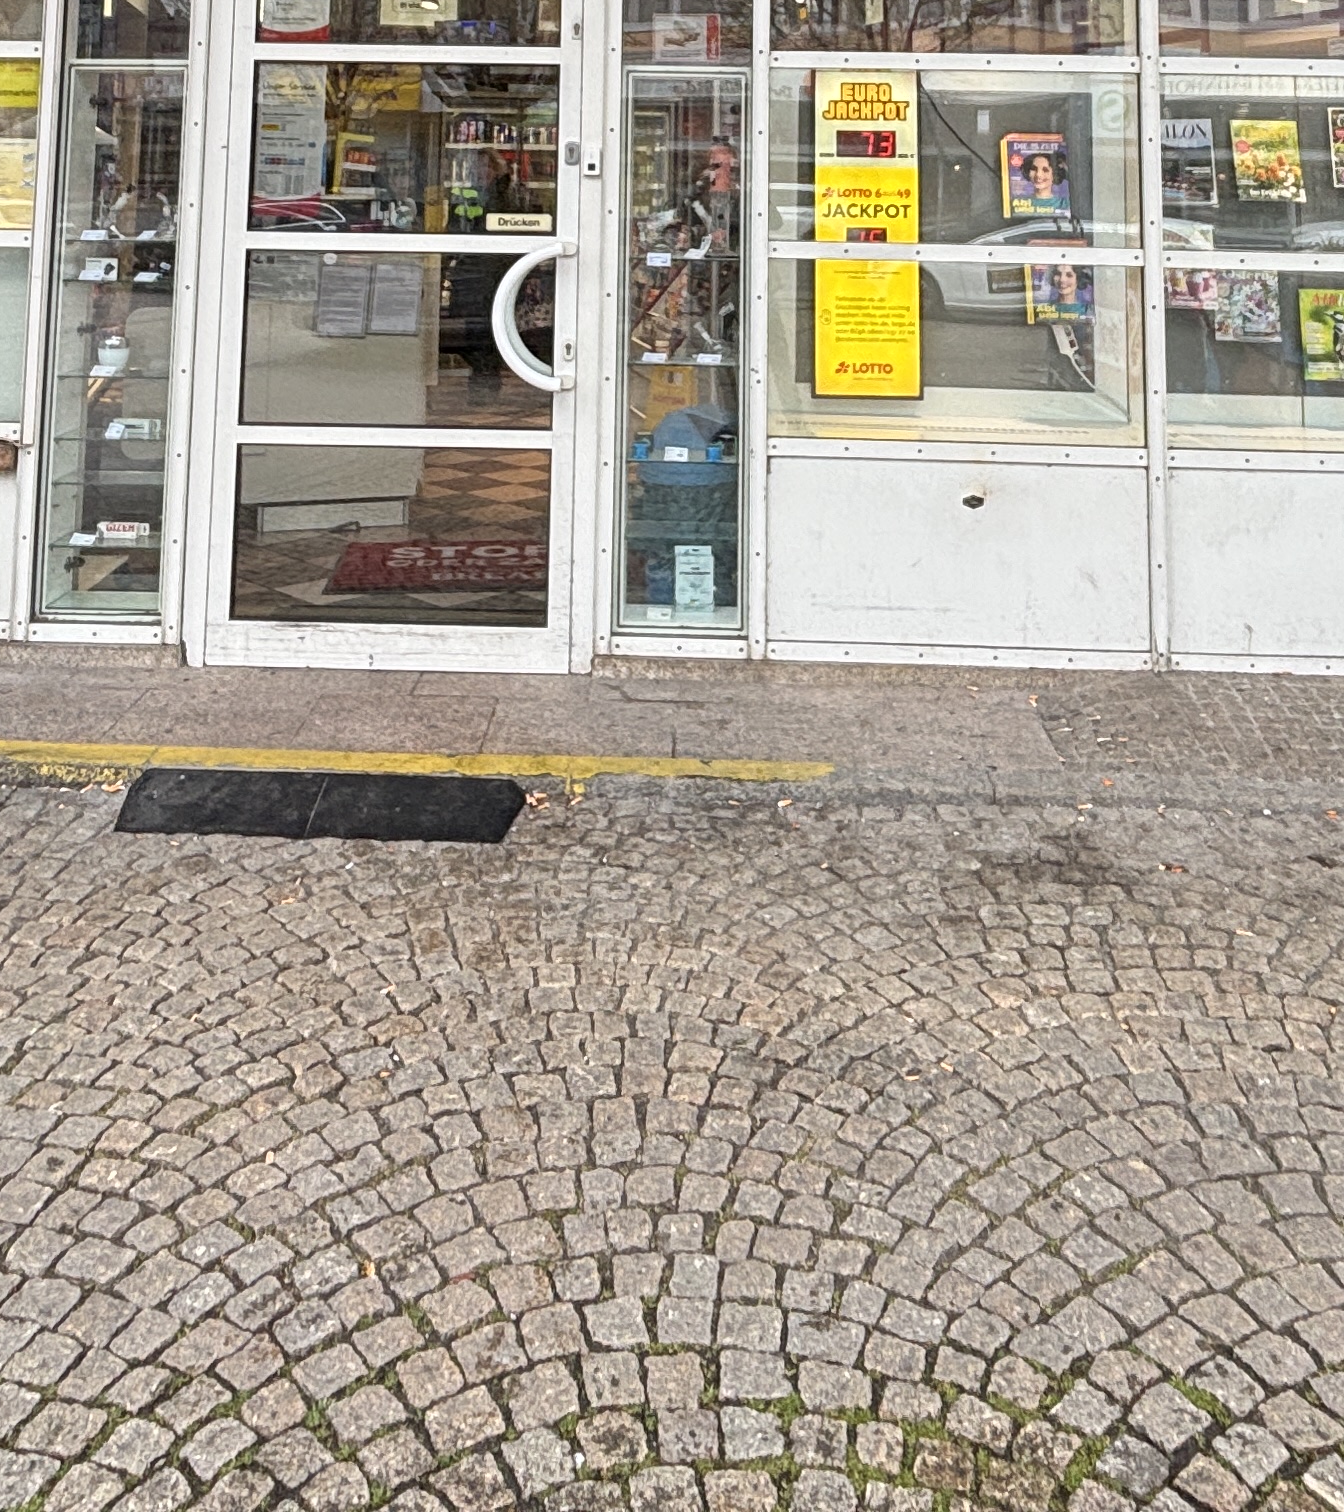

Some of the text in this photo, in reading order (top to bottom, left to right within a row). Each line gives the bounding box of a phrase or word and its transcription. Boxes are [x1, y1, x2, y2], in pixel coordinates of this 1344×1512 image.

[840, 82, 892, 102] EURO
[822, 100, 910, 121] JACKPOT
[860, 131, 893, 157] 73
[837, 188, 872, 198] LOTTO
[822, 203, 912, 219] JACKPOT
[497, 216, 541, 227] Drücken
[852, 362, 894, 375] LOTTO
